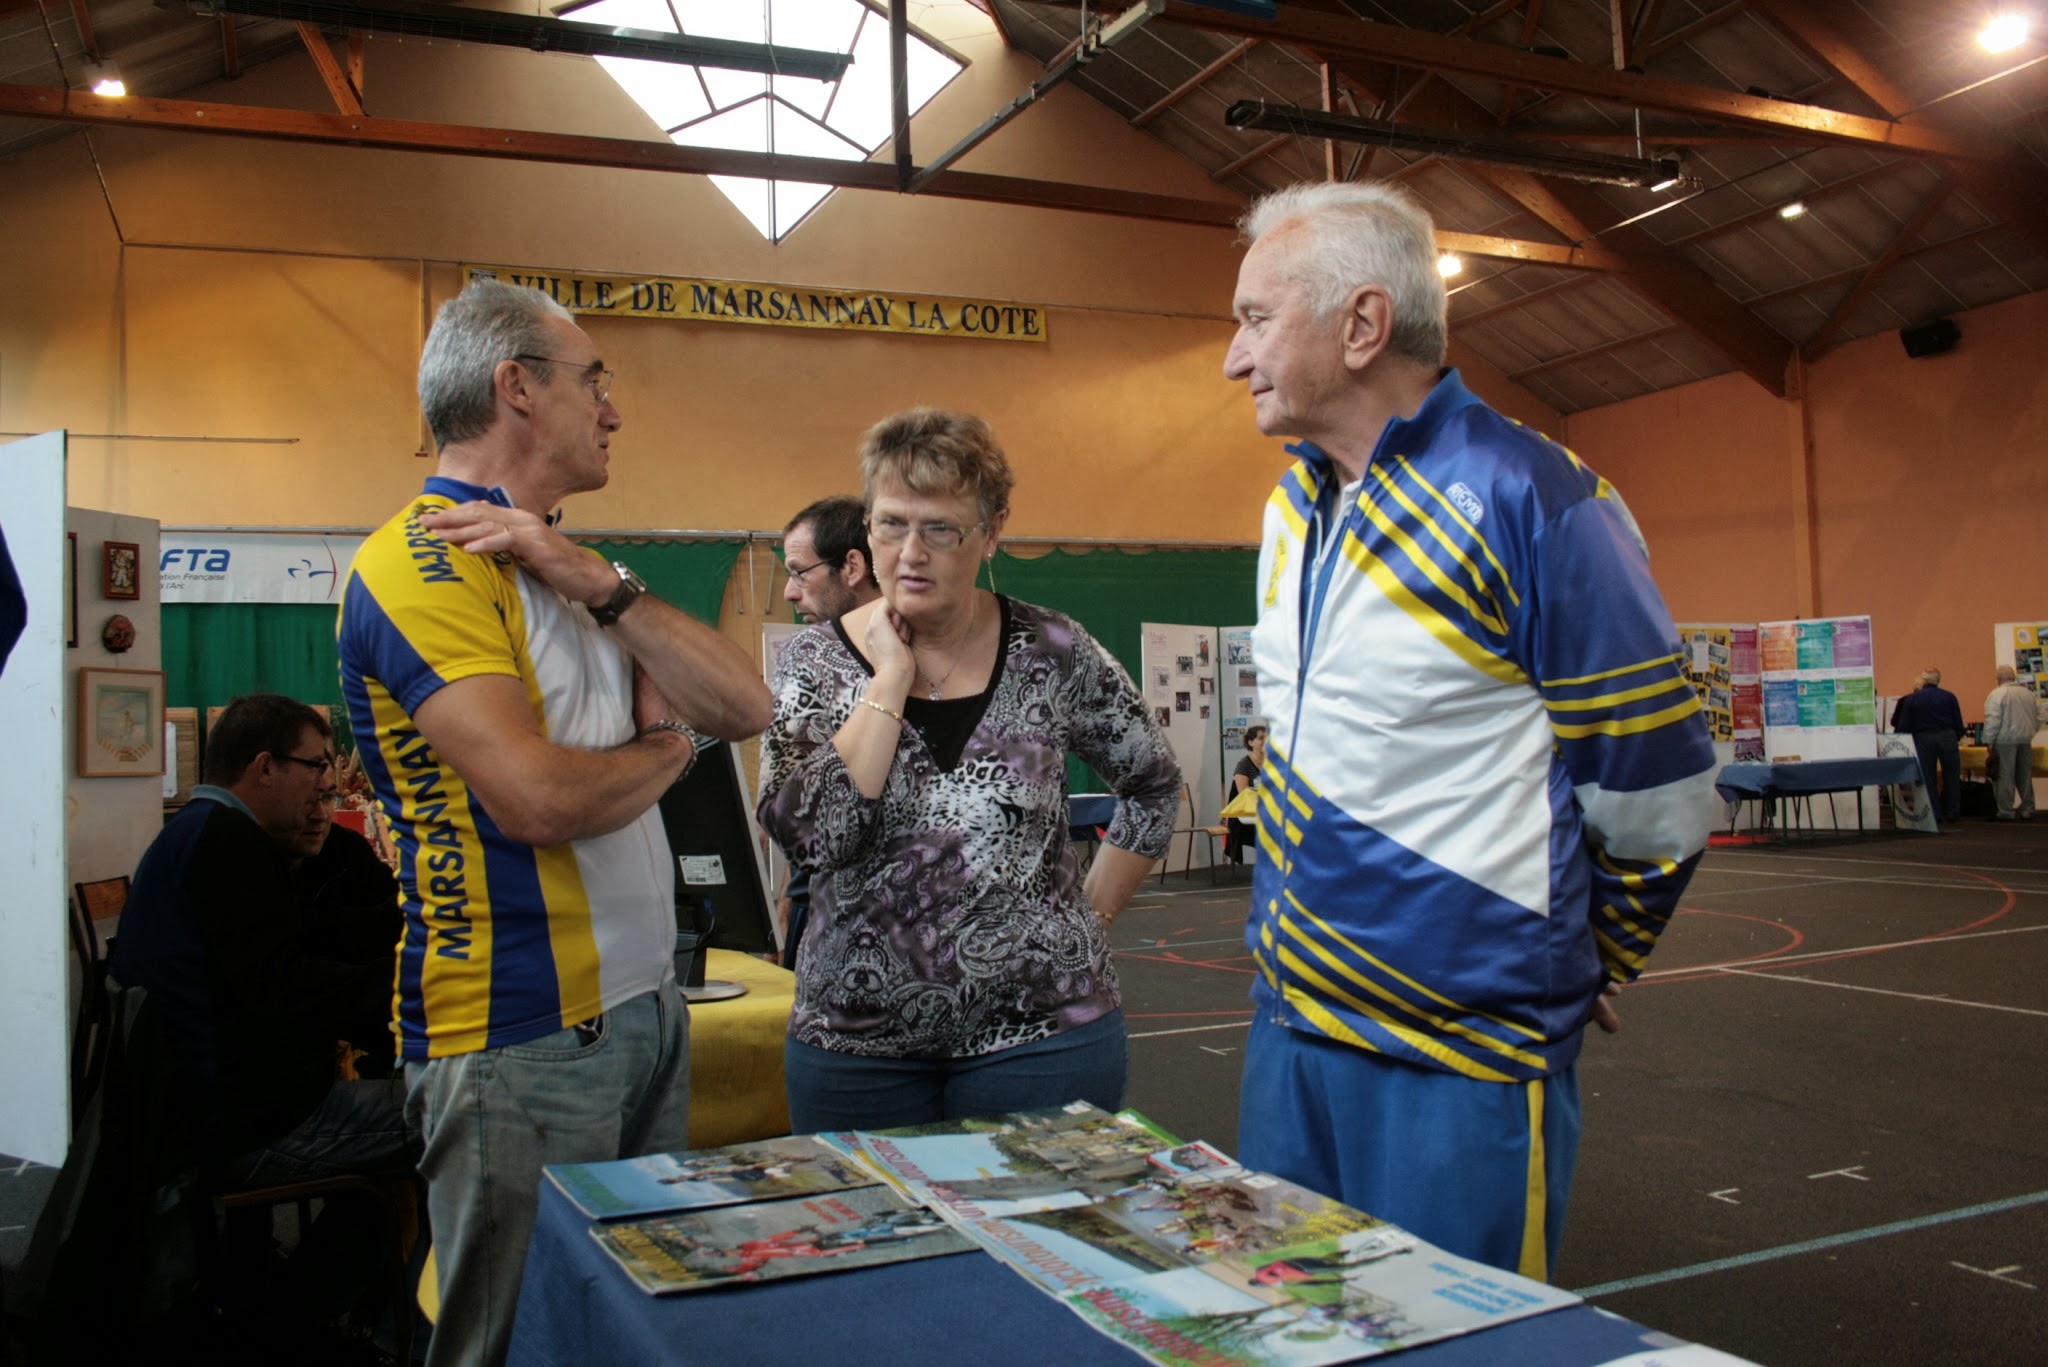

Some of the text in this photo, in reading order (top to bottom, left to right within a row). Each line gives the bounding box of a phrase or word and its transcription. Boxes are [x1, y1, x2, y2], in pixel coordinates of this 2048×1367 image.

[629, 282, 677, 313] DE
[690, 284, 895, 326] MARSANNAY
[907, 300, 950, 330] LA
[960, 303, 1040, 336] COTE
[389, 728, 472, 960] MARSANNAY
